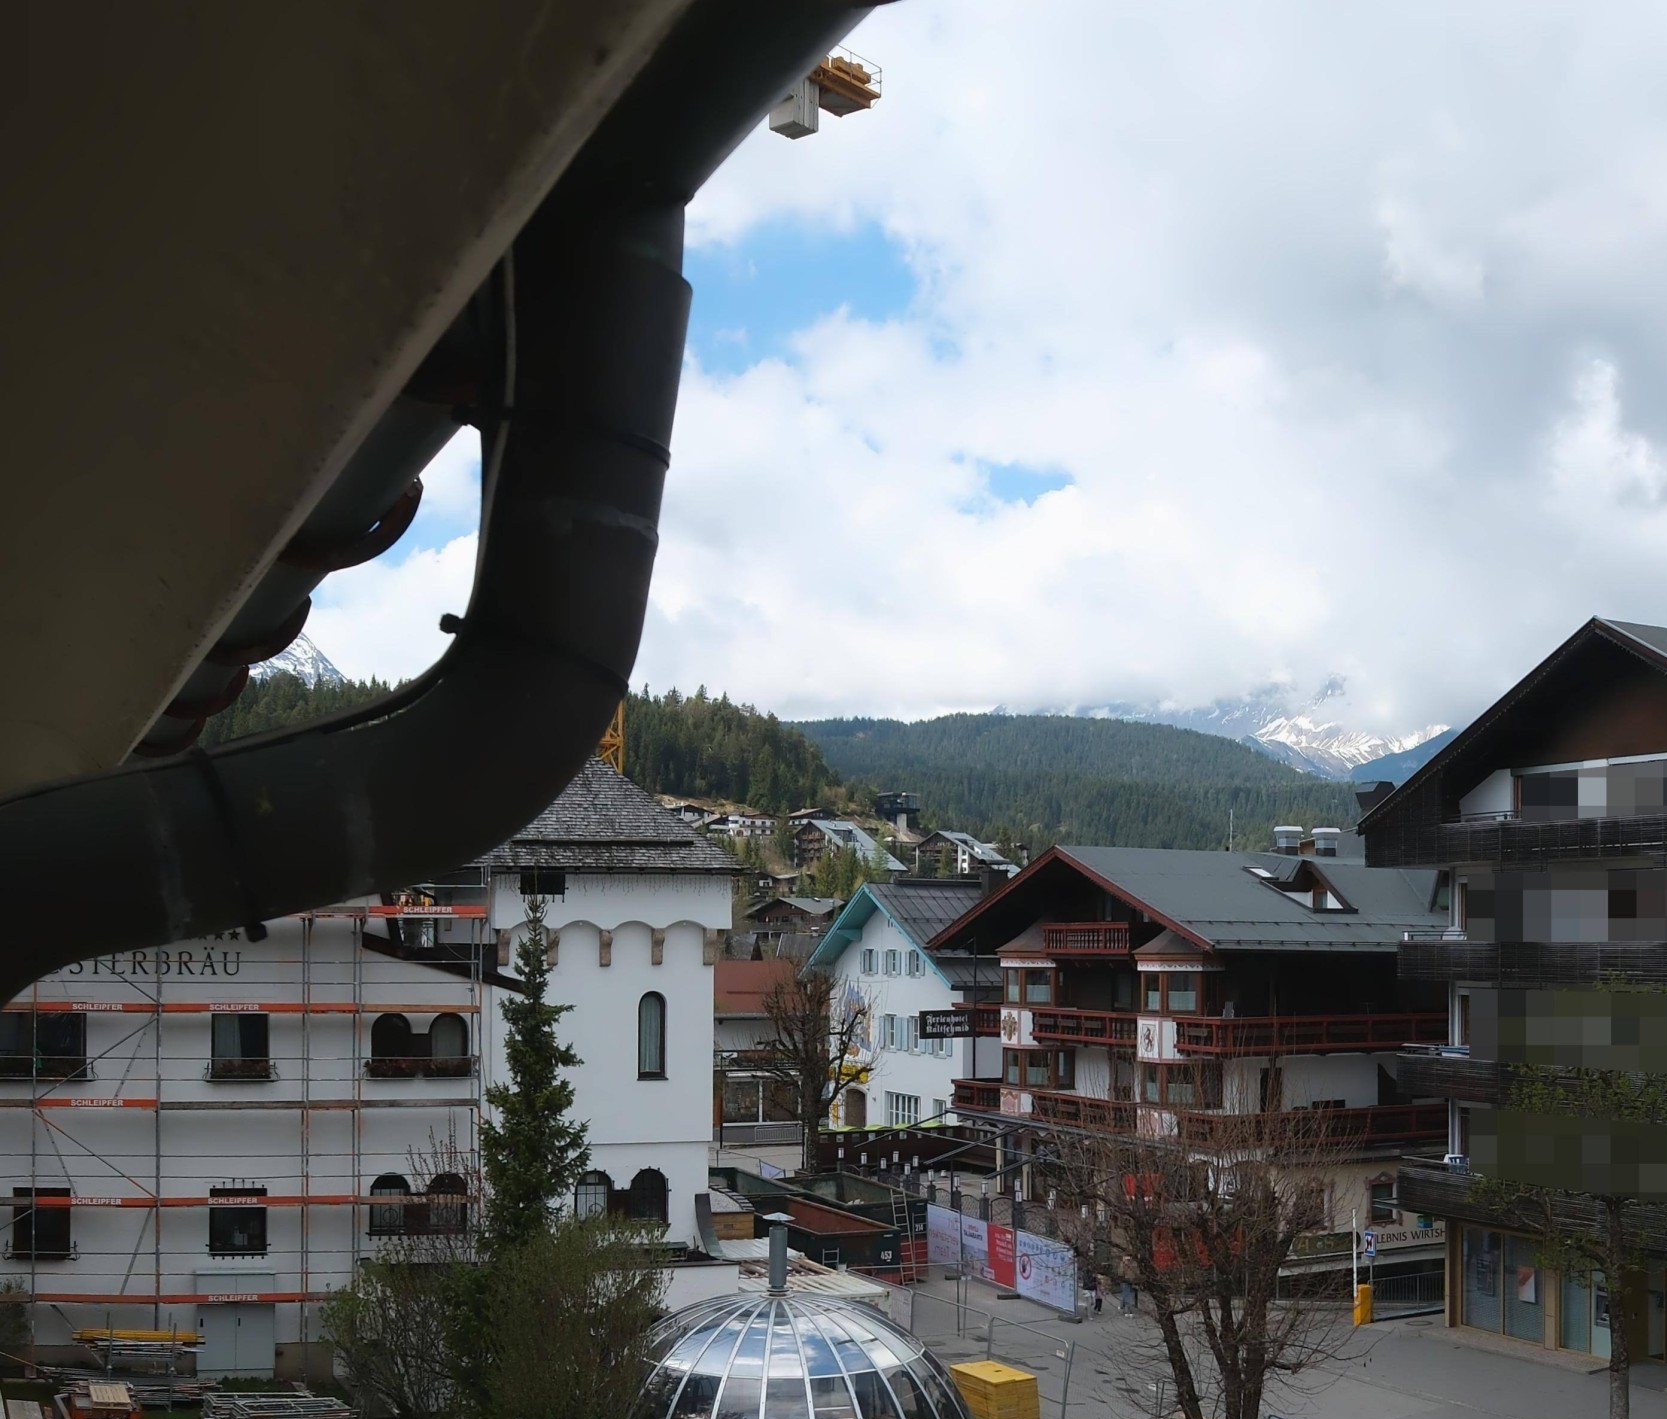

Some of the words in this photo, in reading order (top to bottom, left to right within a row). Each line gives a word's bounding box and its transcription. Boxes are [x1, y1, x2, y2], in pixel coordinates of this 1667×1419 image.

[49, 947, 241, 976] STERBRÄU
[72, 1003, 123, 1011] SCHLEIPFER
[209, 1003, 260, 1011] SCHLEIPFER
[71, 1099, 124, 1107] SCHLEIPFER
[208, 1197, 258, 1205] SCHLEIPFER
[1376, 1231, 1407, 1245] LEBNIS
